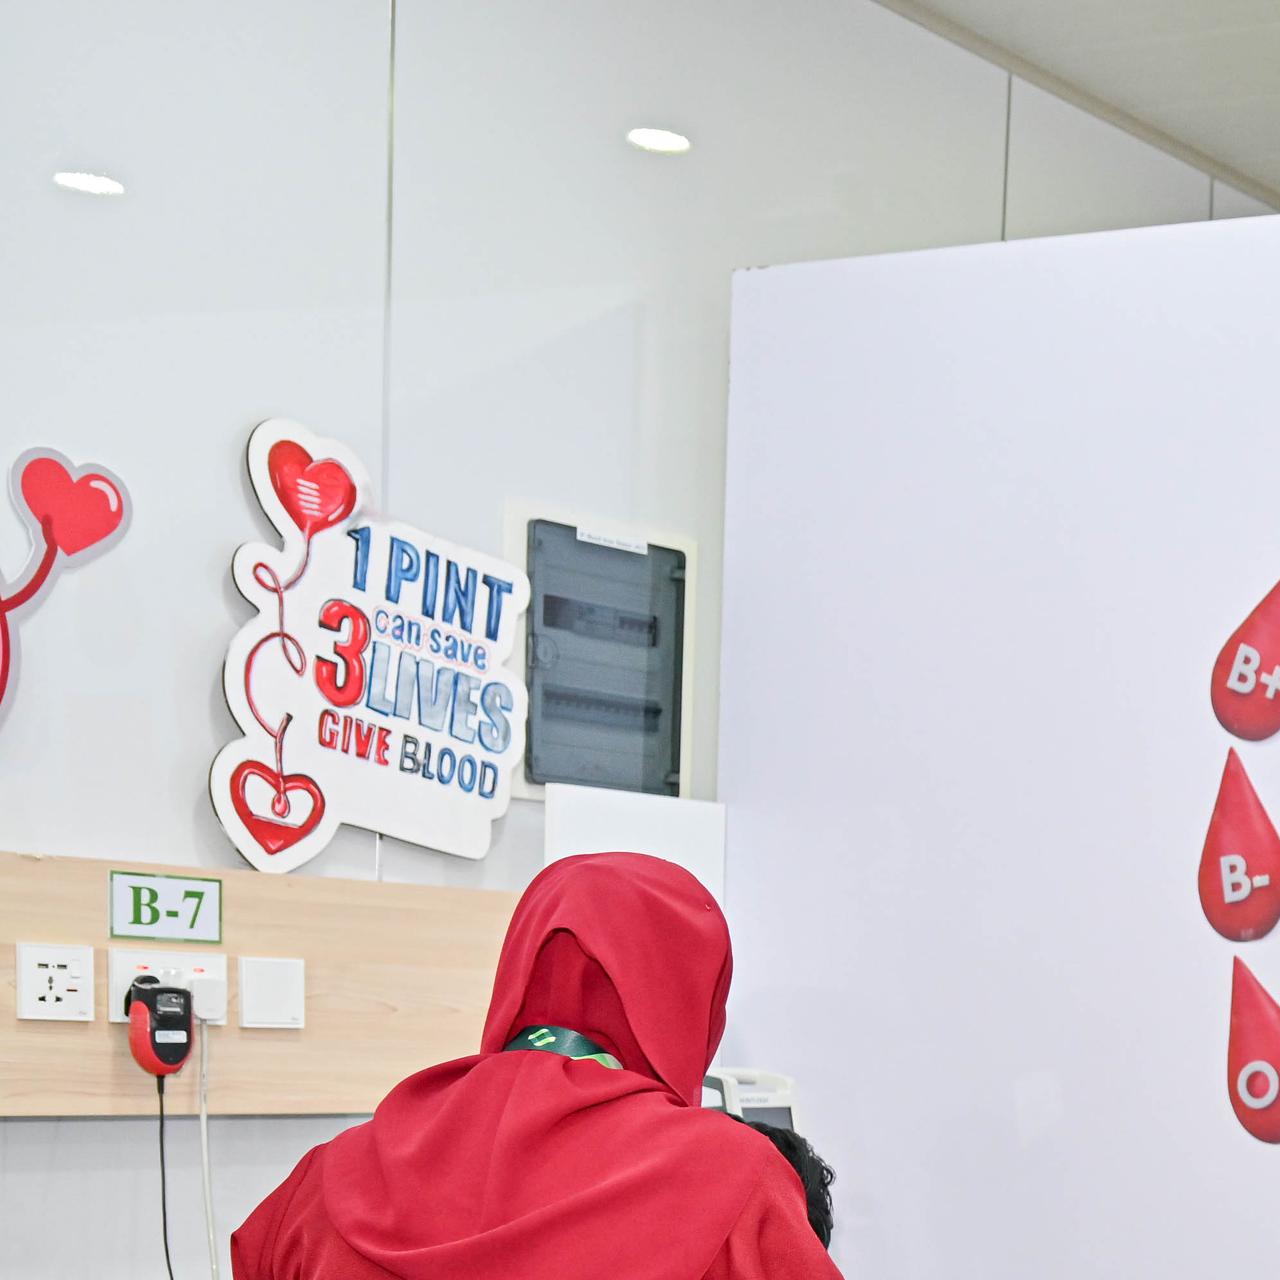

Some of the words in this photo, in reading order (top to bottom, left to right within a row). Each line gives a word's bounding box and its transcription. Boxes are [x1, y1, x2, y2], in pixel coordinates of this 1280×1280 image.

[347, 526, 371, 592] 1
[385, 536, 513, 642] PINT
[315, 598, 371, 708] 3
[365, 640, 514, 754] LIVES
[375, 609, 421, 647] can
[429, 626, 488, 671] save
[318, 708, 392, 766] GIVE
[399, 734, 499, 800] BLOOD
[128, 885, 206, 929] B-7
[1219, 854, 1270, 905] B-
